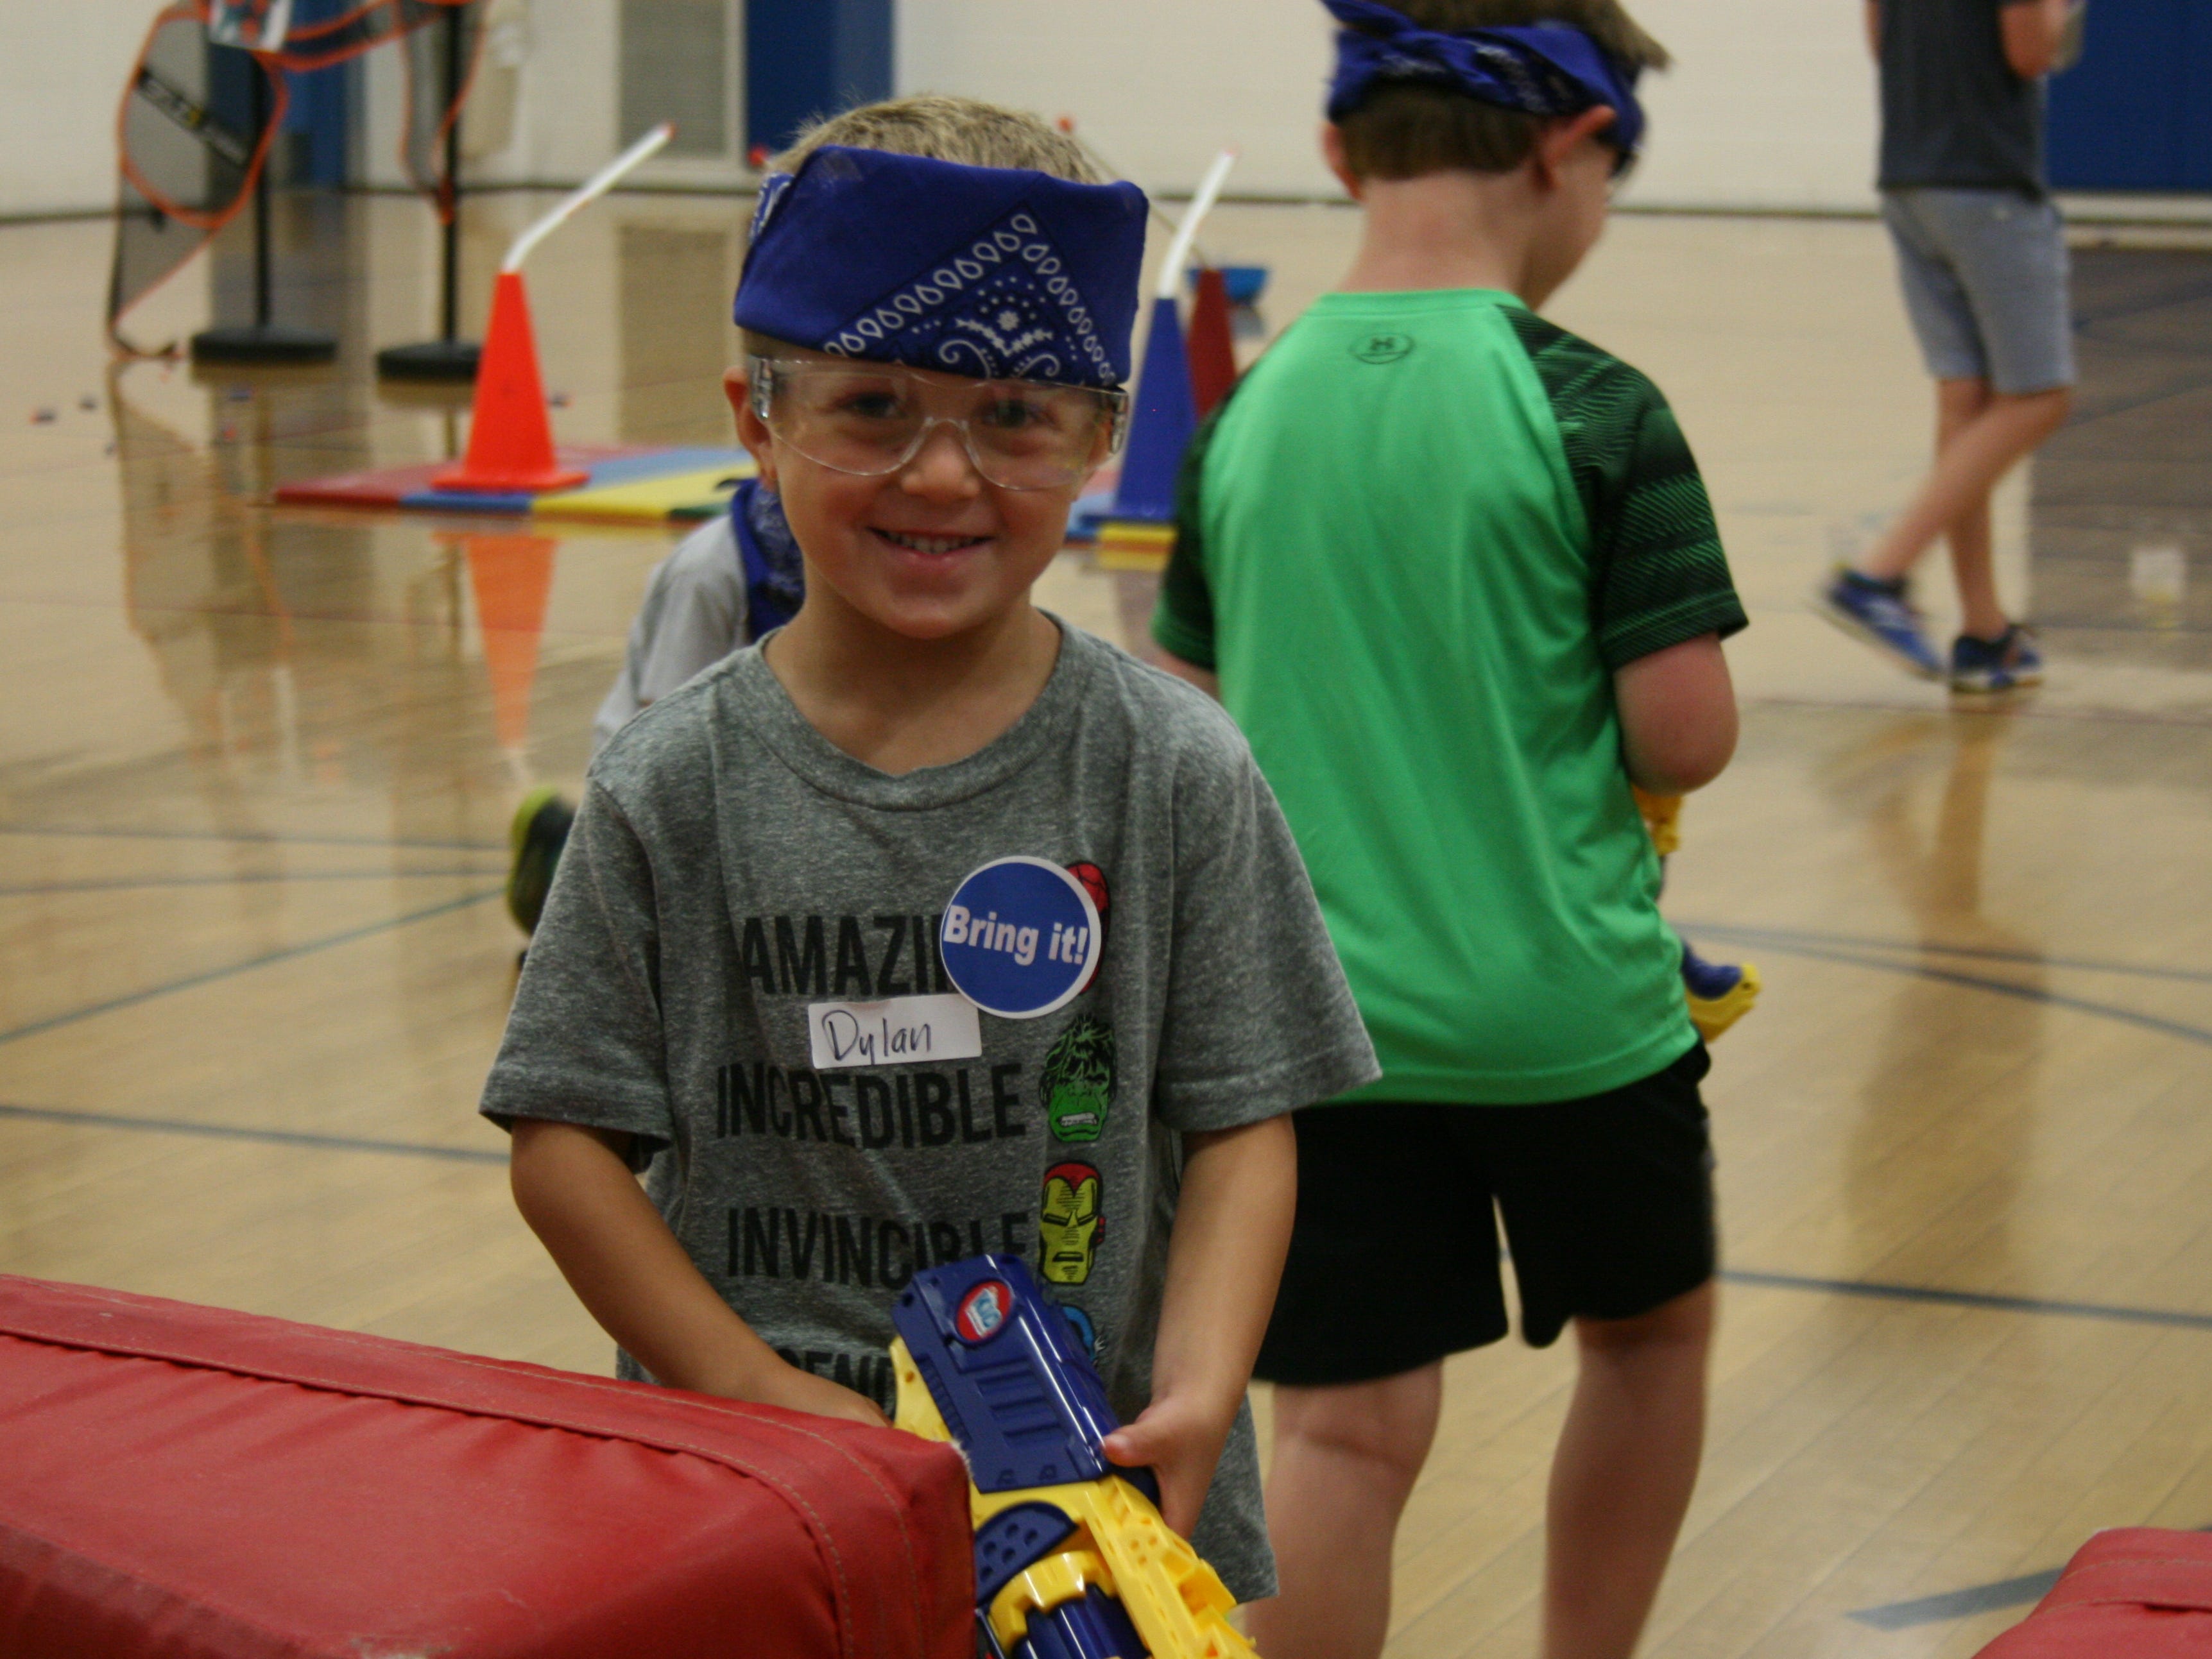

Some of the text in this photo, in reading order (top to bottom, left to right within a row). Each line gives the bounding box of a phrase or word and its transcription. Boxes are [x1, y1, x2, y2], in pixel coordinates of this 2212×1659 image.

[943, 905, 1088, 966] Bring it!
[821, 1009, 931, 1066] Dylan
[716, 1062, 1027, 1149] INCREDIBLE
